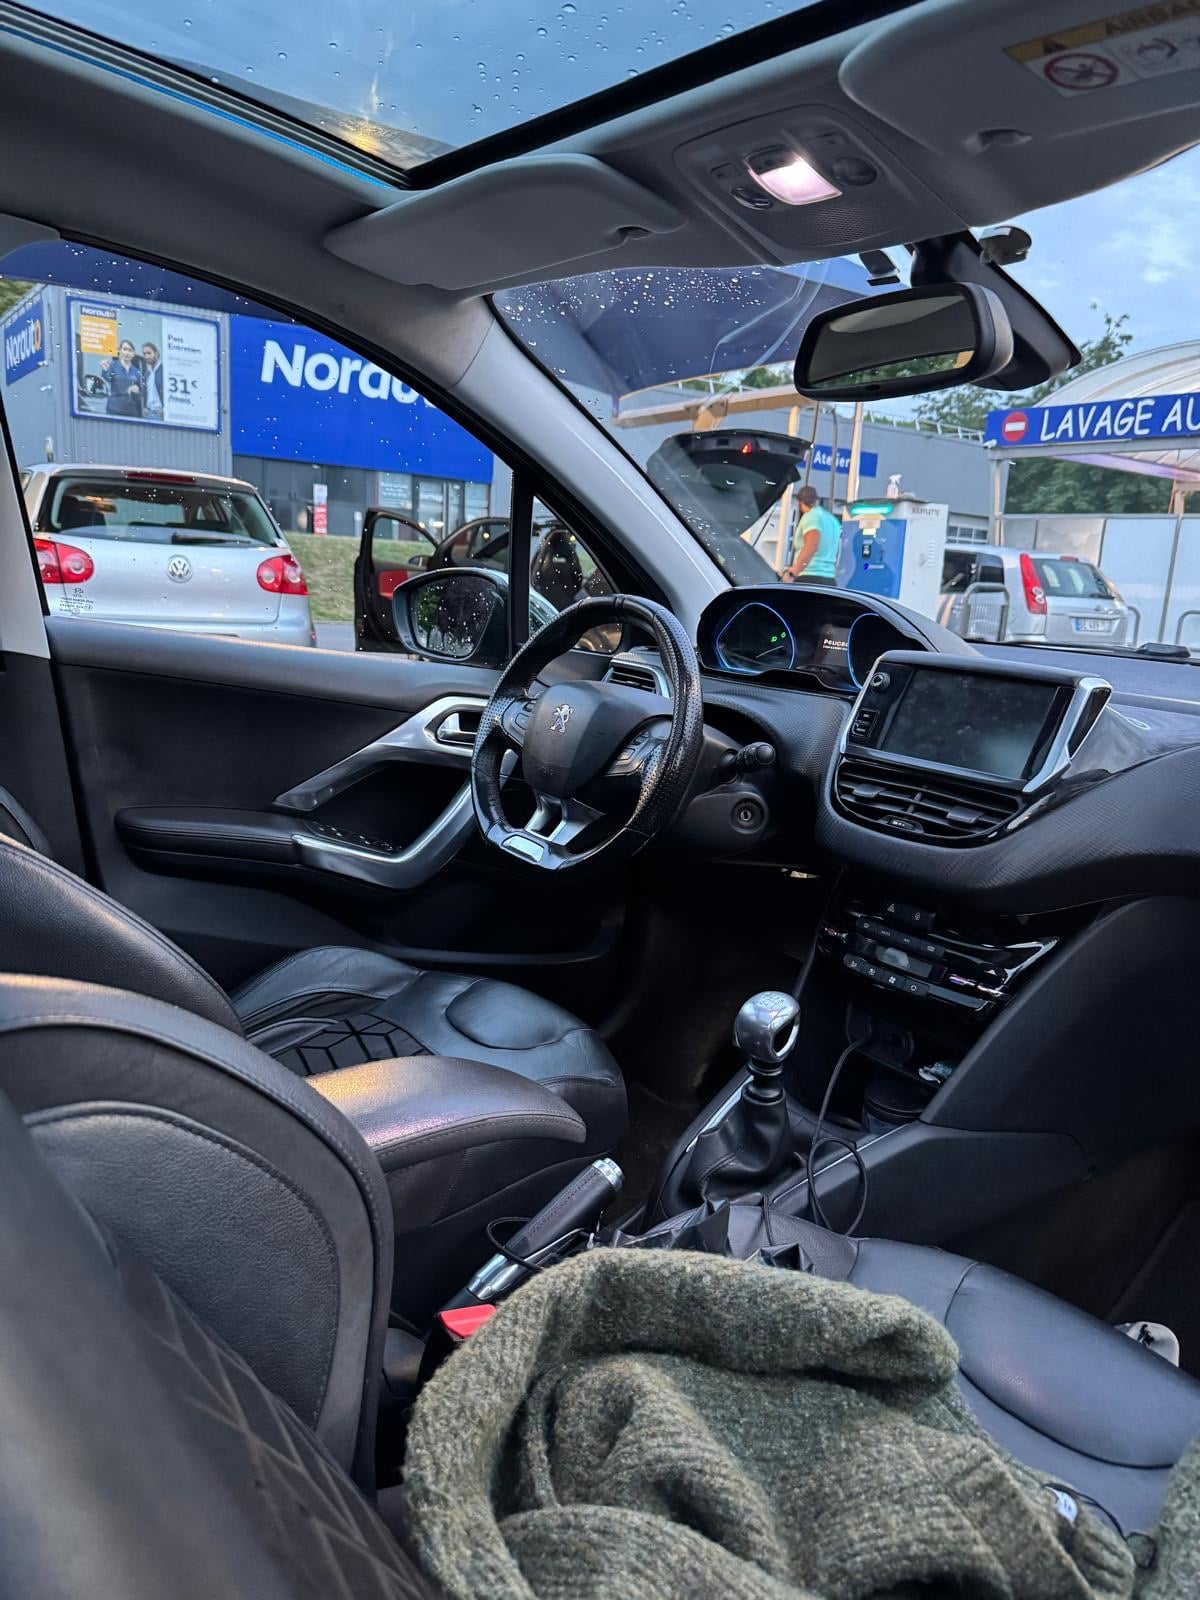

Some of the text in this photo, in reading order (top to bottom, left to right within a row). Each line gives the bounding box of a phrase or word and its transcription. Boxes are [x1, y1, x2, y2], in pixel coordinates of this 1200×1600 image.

[6, 317, 42, 370] Norauto
[261, 339, 438, 409] Norau
[1040, 399, 1156, 441] LAVAGE
[813, 451, 851, 468] Ateier
